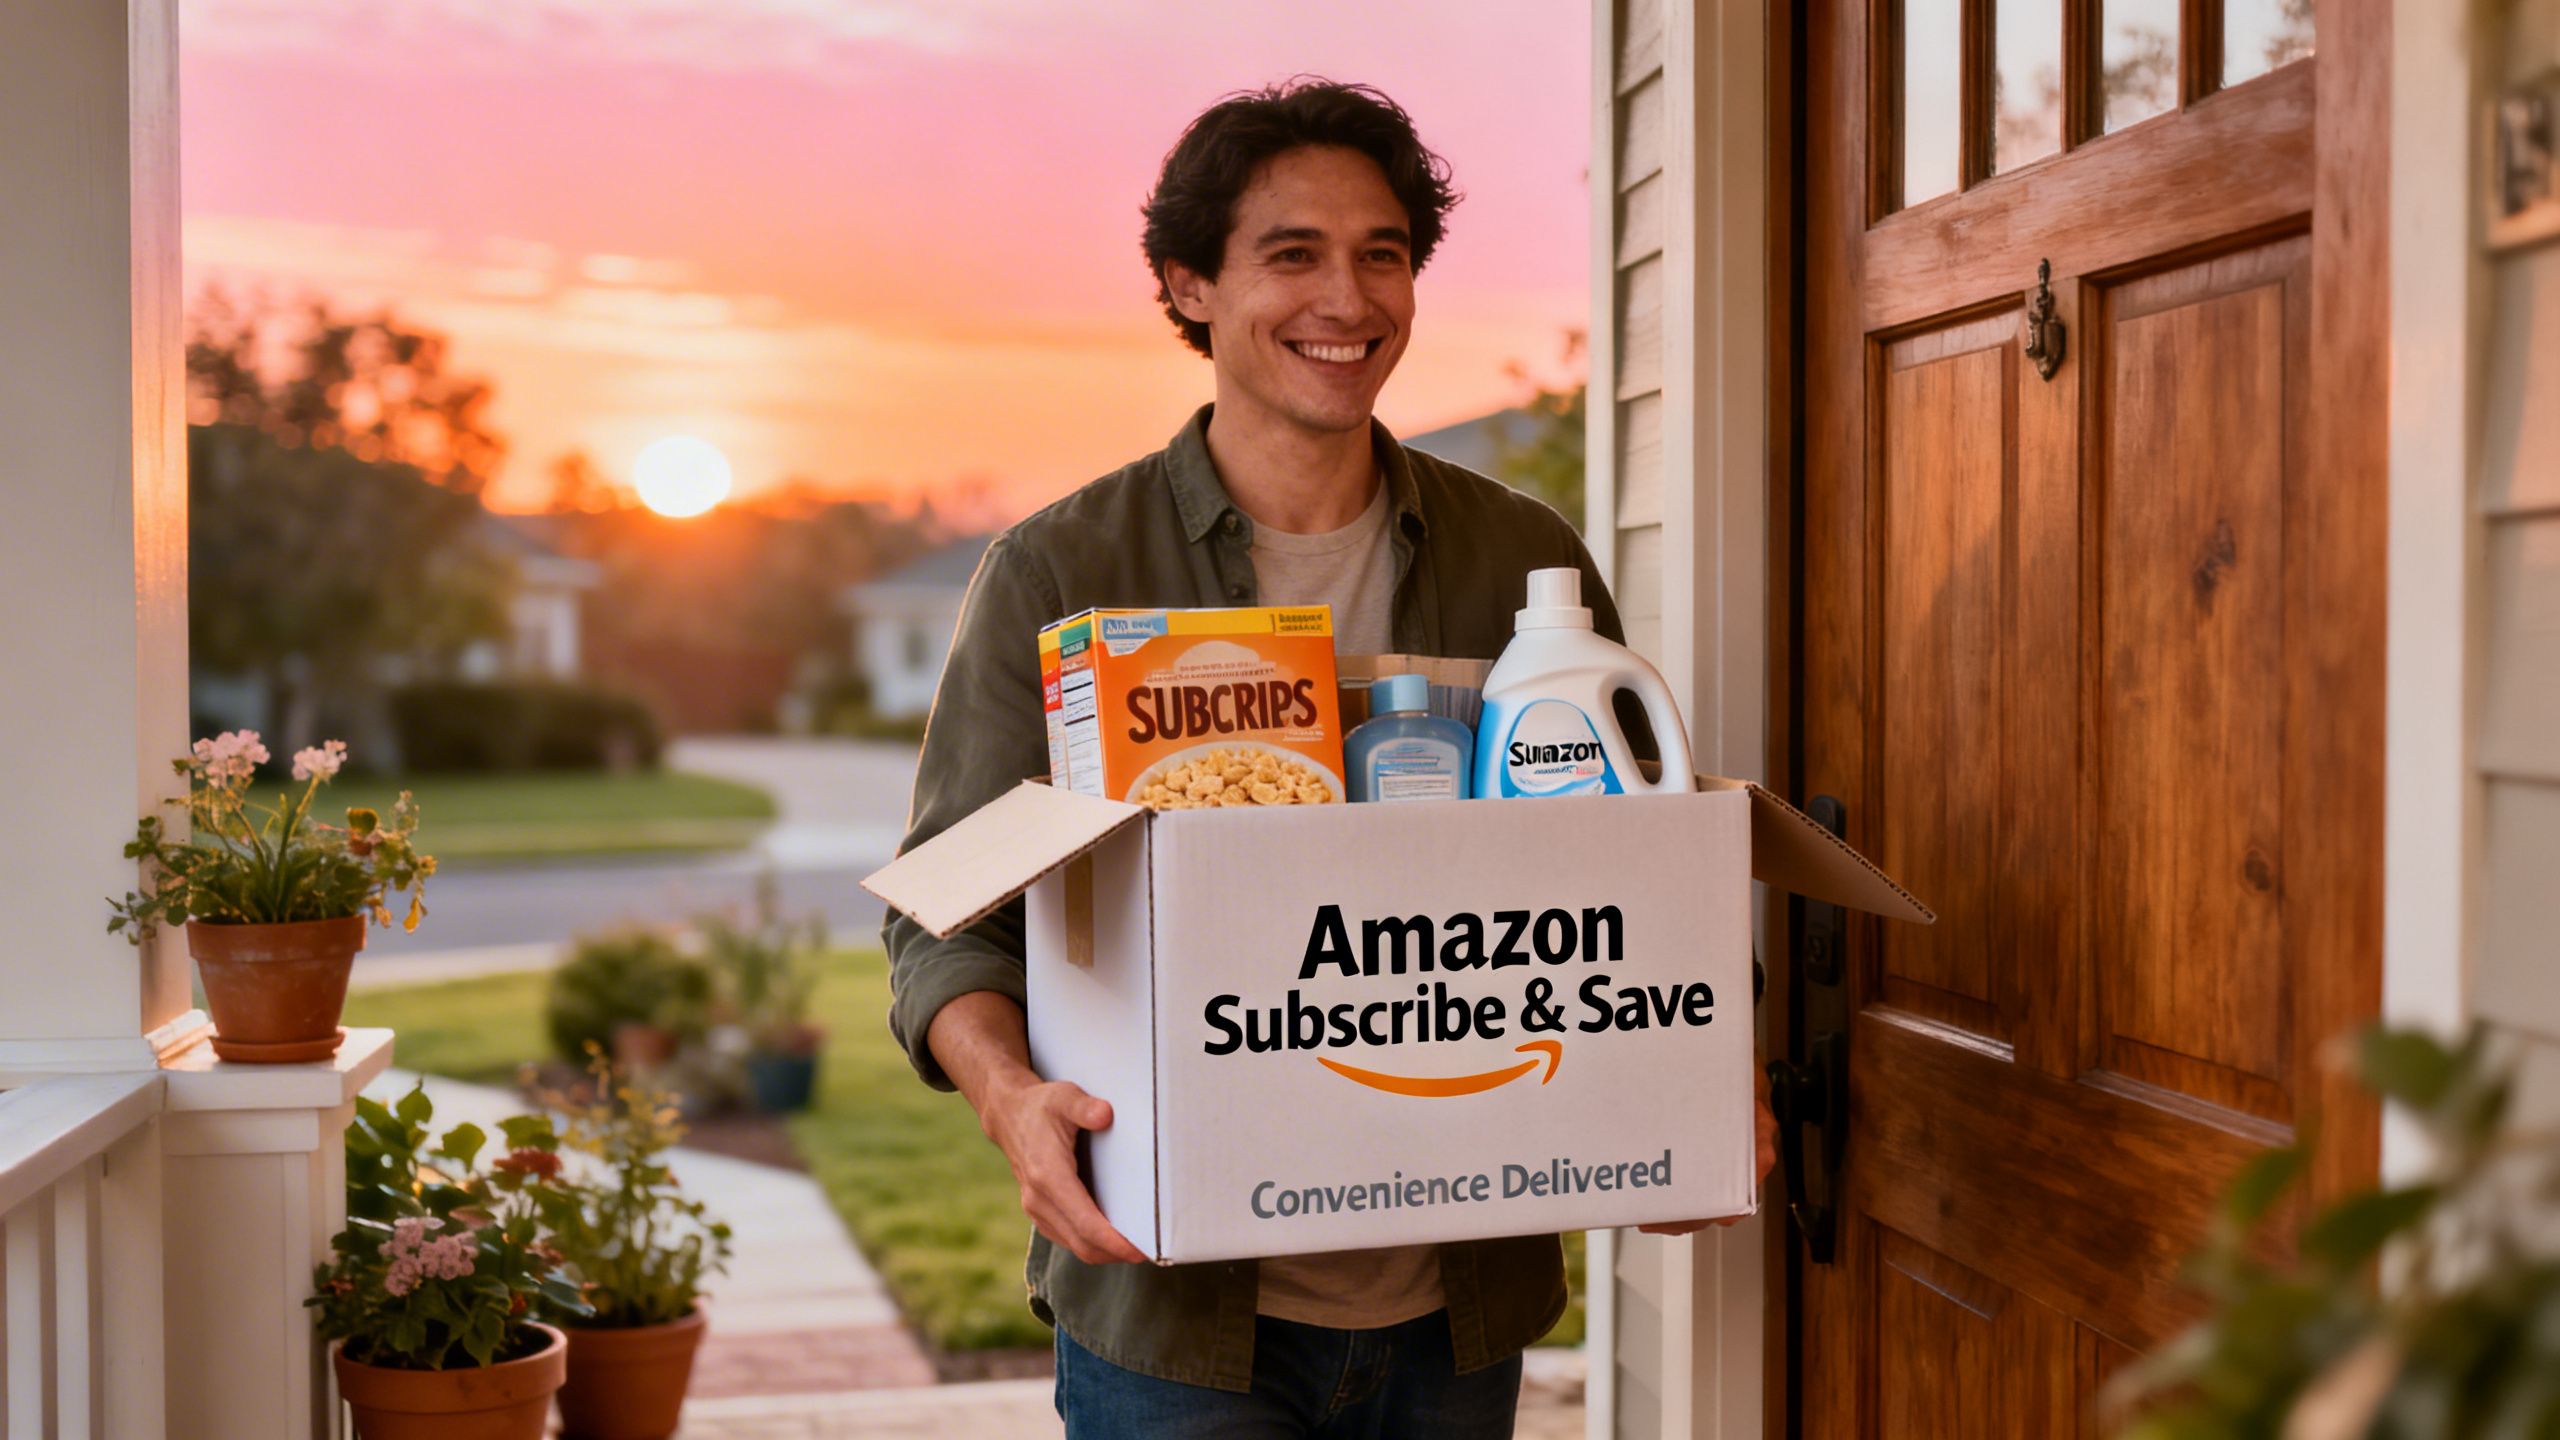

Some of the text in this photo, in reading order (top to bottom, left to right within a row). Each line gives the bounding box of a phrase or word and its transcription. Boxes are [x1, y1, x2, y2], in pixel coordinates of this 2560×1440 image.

[1126, 678, 1318, 744] SUBCRIPS
[1297, 904, 1624, 980] Amazon
[1203, 974, 1714, 1055] Subscribe & Save
[1250, 1148, 1672, 1219] Convenience Delivered
